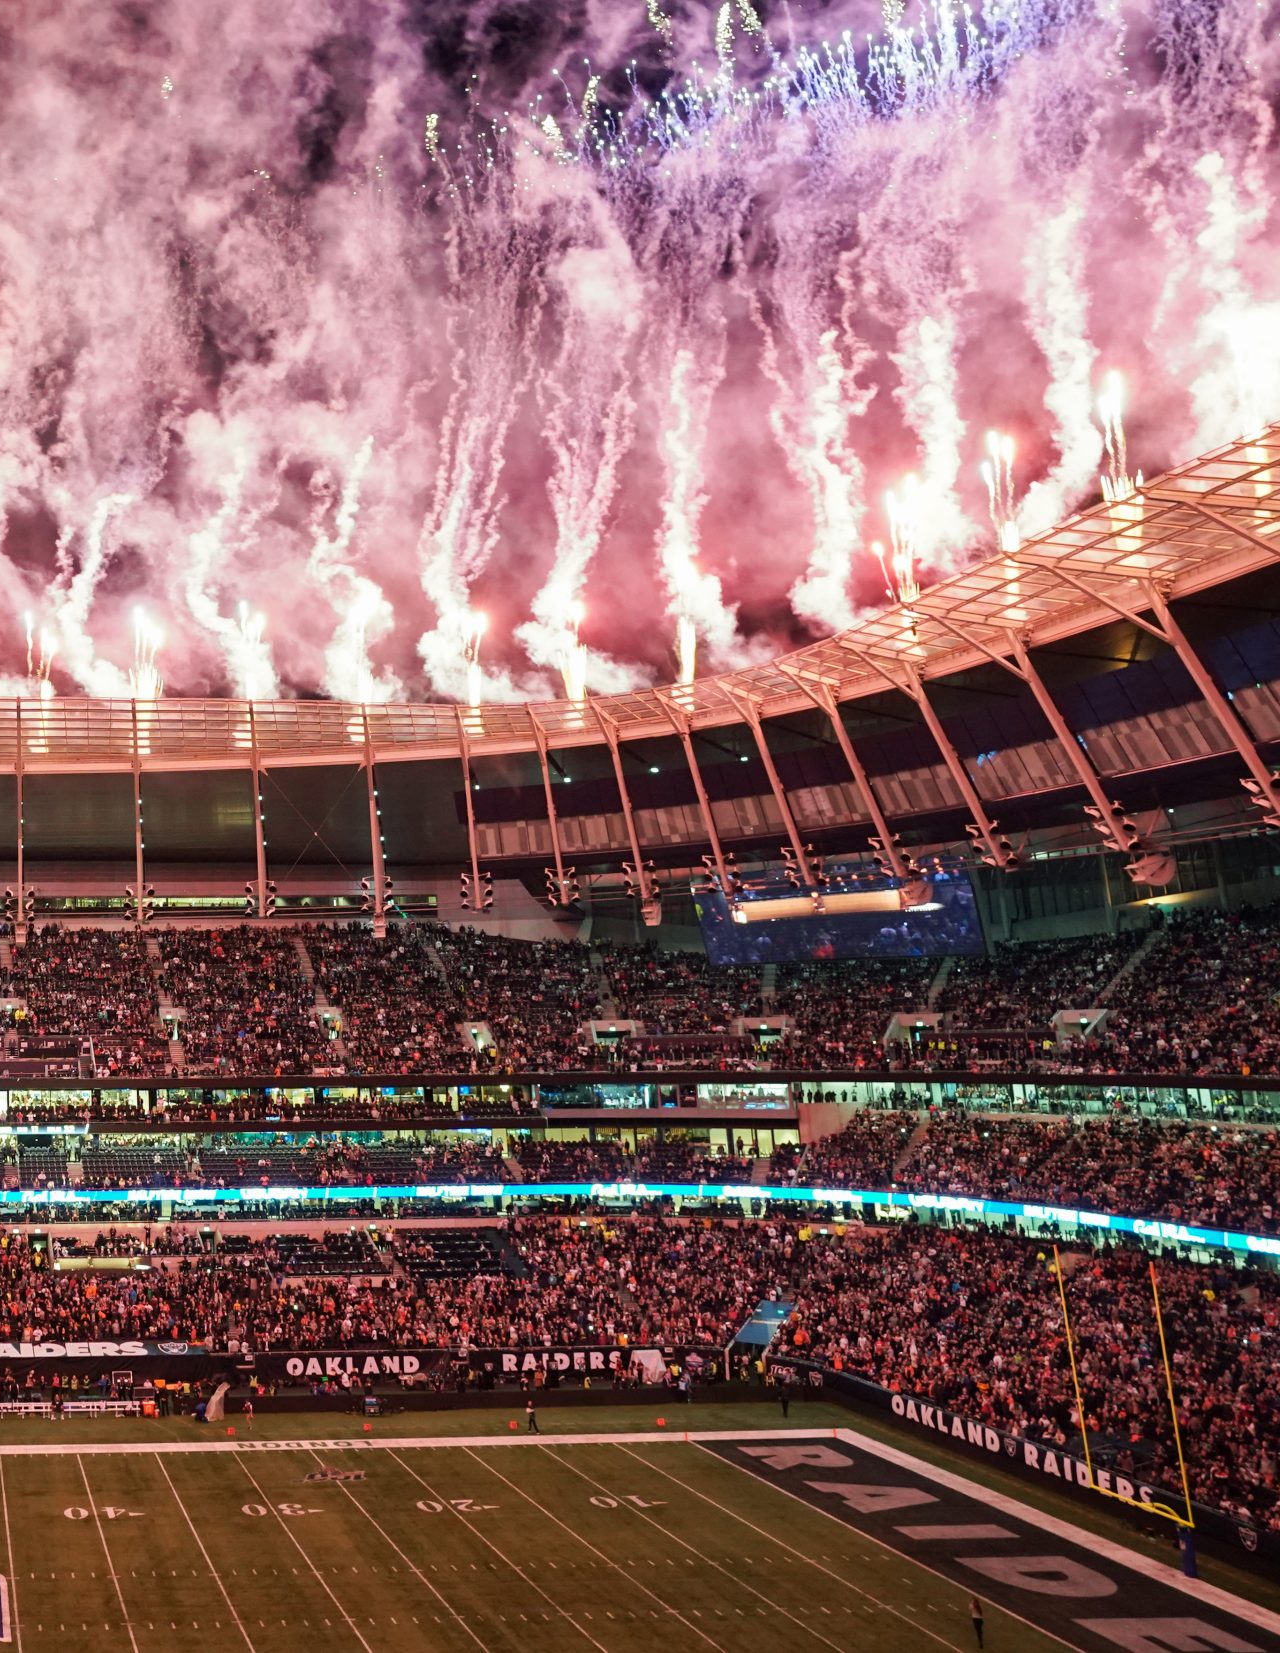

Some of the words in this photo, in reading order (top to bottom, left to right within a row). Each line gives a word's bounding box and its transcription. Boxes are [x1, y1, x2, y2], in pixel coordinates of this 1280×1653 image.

[286, 1356, 420, 1376] OAKLAND
[502, 1351, 621, 1371] RAIDERS
[236, 1440, 373, 1449] LONDON
[891, 1394, 1000, 1452] OAKLAND
[1023, 1442, 1155, 1513] RAIDERS
